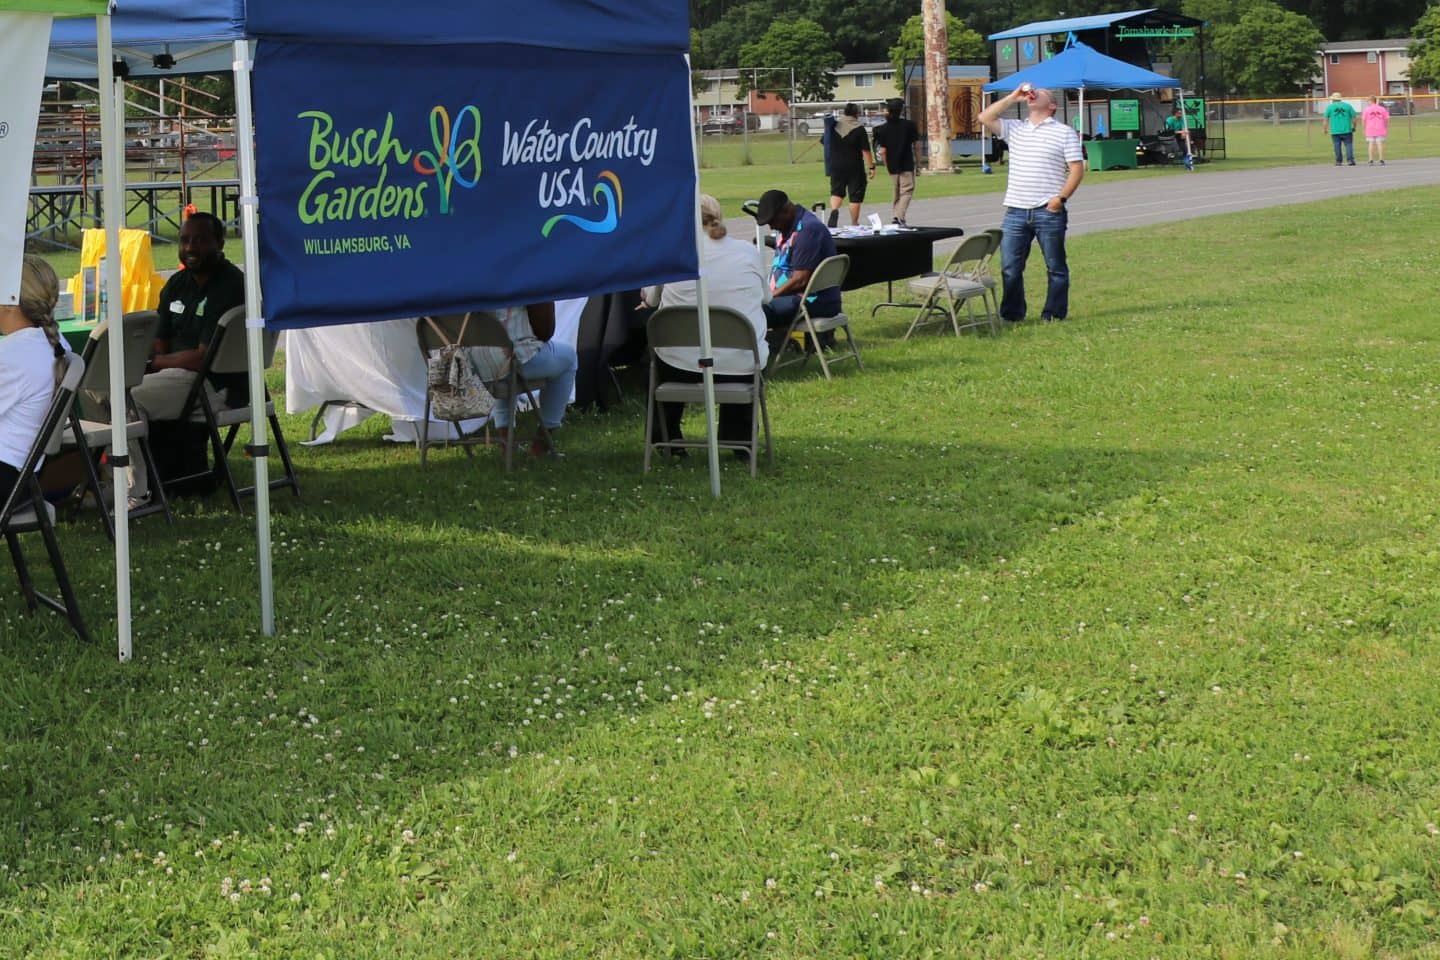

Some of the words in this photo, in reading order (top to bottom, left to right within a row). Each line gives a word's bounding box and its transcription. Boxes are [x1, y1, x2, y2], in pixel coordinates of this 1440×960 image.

[297, 110, 412, 171] Busch
[501, 118, 570, 167] Water
[569, 115, 658, 167] Country
[297, 162, 428, 224] Gardens
[538, 167, 587, 209] USA
[303, 235, 394, 256] WILLIAMSBURG,
[394, 233, 412, 249] VA
